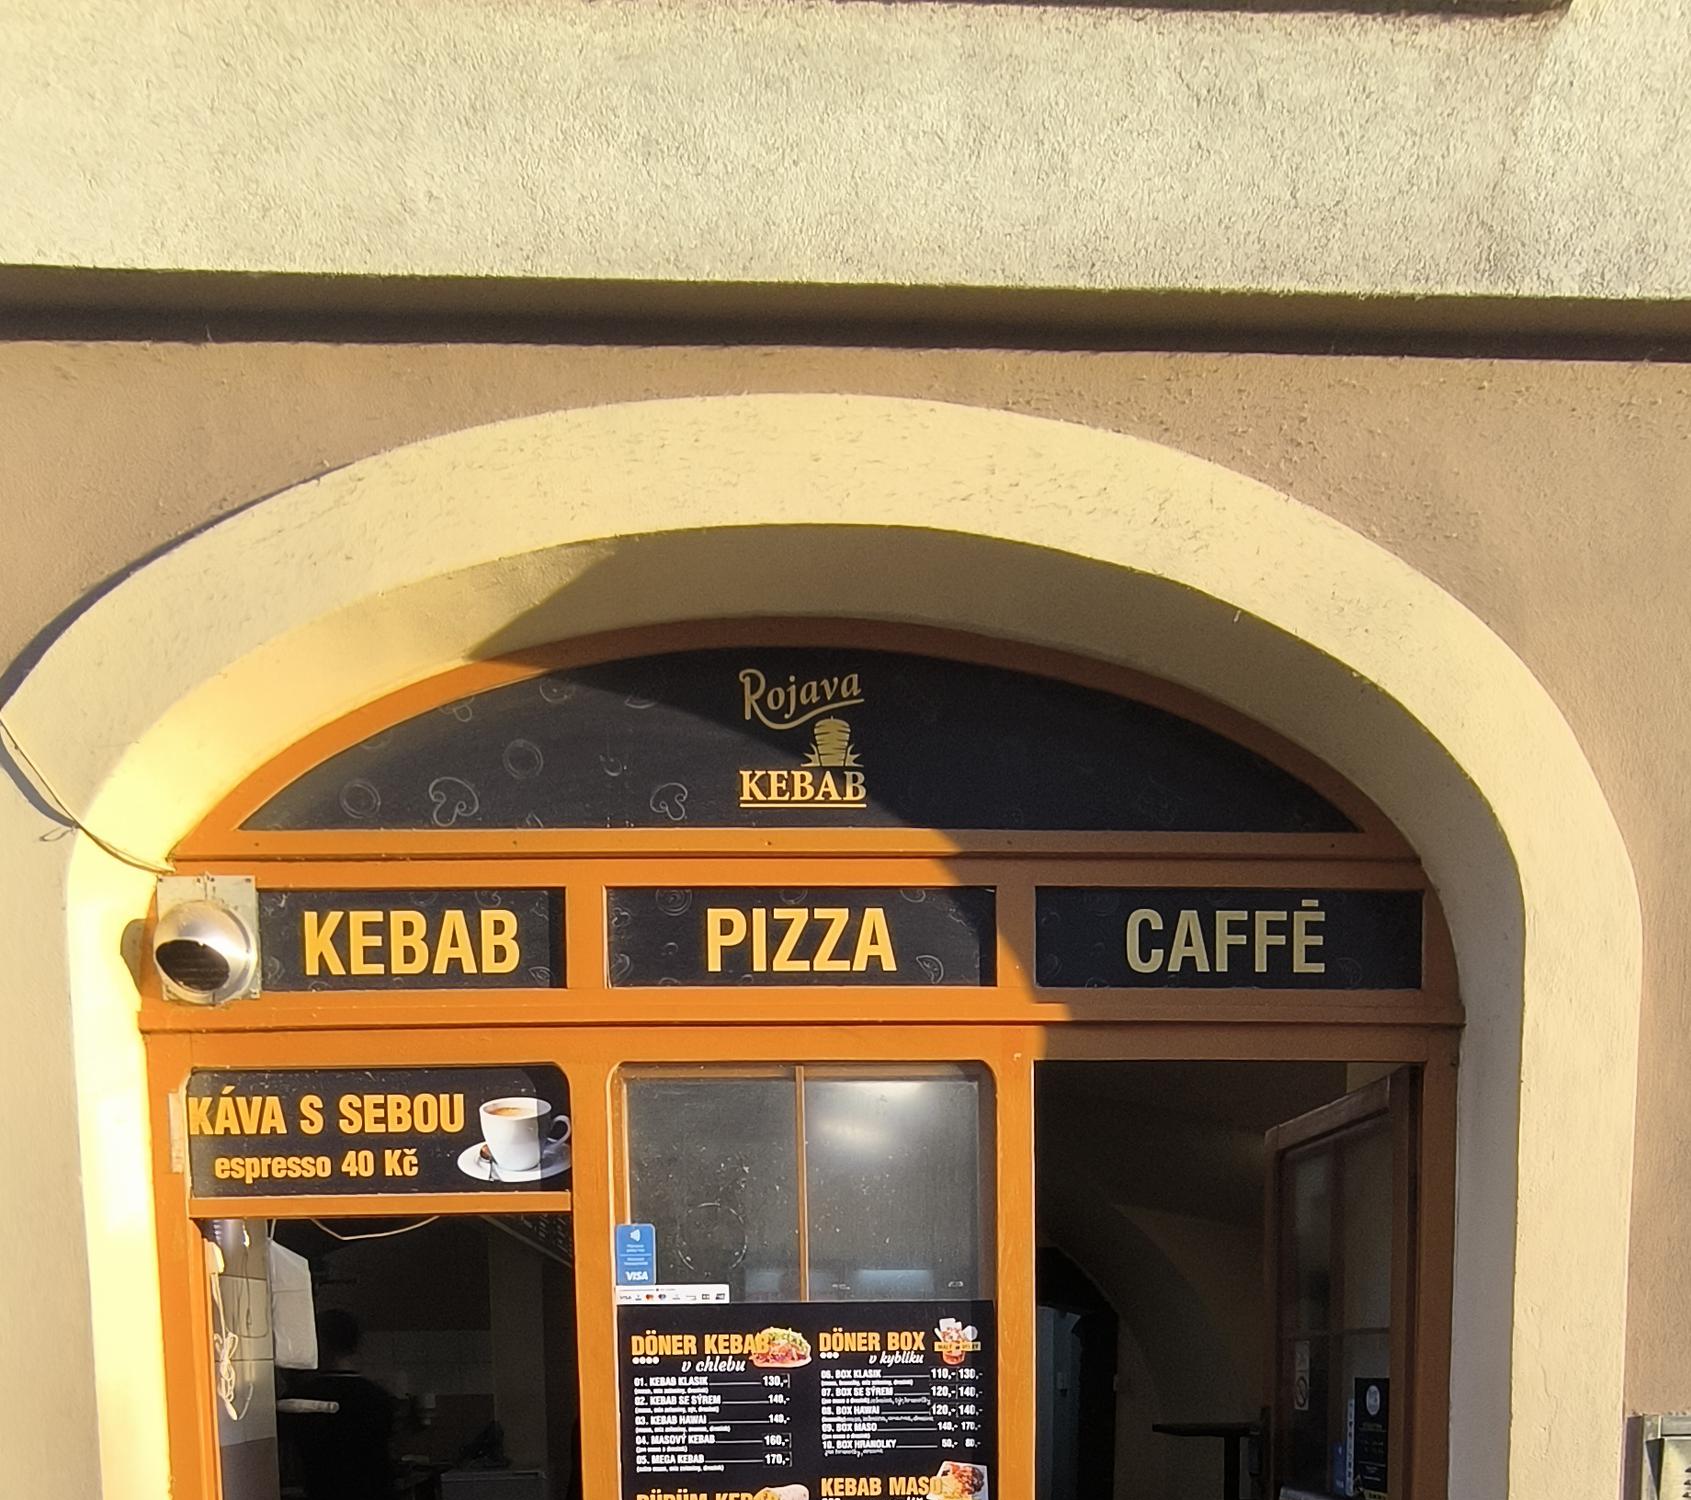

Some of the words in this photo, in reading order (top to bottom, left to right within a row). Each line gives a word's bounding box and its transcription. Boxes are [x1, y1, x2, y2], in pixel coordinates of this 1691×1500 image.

[739, 669, 864, 730] Rojava
[739, 771, 867, 800] KEBAB
[303, 908, 521, 976] KEBAB
[707, 907, 897, 972] PIZZA
[189, 1086, 286, 1136] KÁVA
[300, 1095, 323, 1134] S
[339, 1093, 465, 1134] SEBOU
[215, 1154, 331, 1183] espresso
[342, 1150, 373, 1177] 40
[385, 1149, 418, 1177] Kč
[626, 1271, 648, 1280] VISA
[631, 1330, 697, 1356] DÖNER
[704, 1334, 770, 1354] KEBAB
[819, 1328, 880, 1352] DÖNER
[887, 1332, 925, 1350] BOX
[682, 1361, 691, 1372] v
[696, 1356, 745, 1372] chlebu
[869, 1355, 876, 1364] v
[634, 1377, 647, 1387] 01.
[650, 1377, 677, 1386] KEBAB
[678, 1376, 708, 1386] KLASIK
[763, 1376, 787, 1387] 130,-
[836, 1370, 852, 1378] BOX
[853, 1370, 882, 1378] KLASIK
[836, 1388, 852, 1396] BOX
[854, 1388, 864, 1396] SE
[866, 1385, 893, 1395] SÝREM
[650, 1396, 677, 1405] KEBAB
[679, 1396, 689, 1405] SE
[691, 1394, 721, 1405] SÝREM
[650, 1415, 677, 1424] KEBAB
[679, 1415, 707, 1424] HAWAI
[651, 1432, 686, 1444] MASOVÝ
[688, 1435, 715, 1444] KEBAB
[652, 1455, 675, 1463] MEGA
[678, 1454, 704, 1463] KEBAB
[821, 1478, 881, 1497] KEBAB
[889, 1477, 942, 1495] MASO
